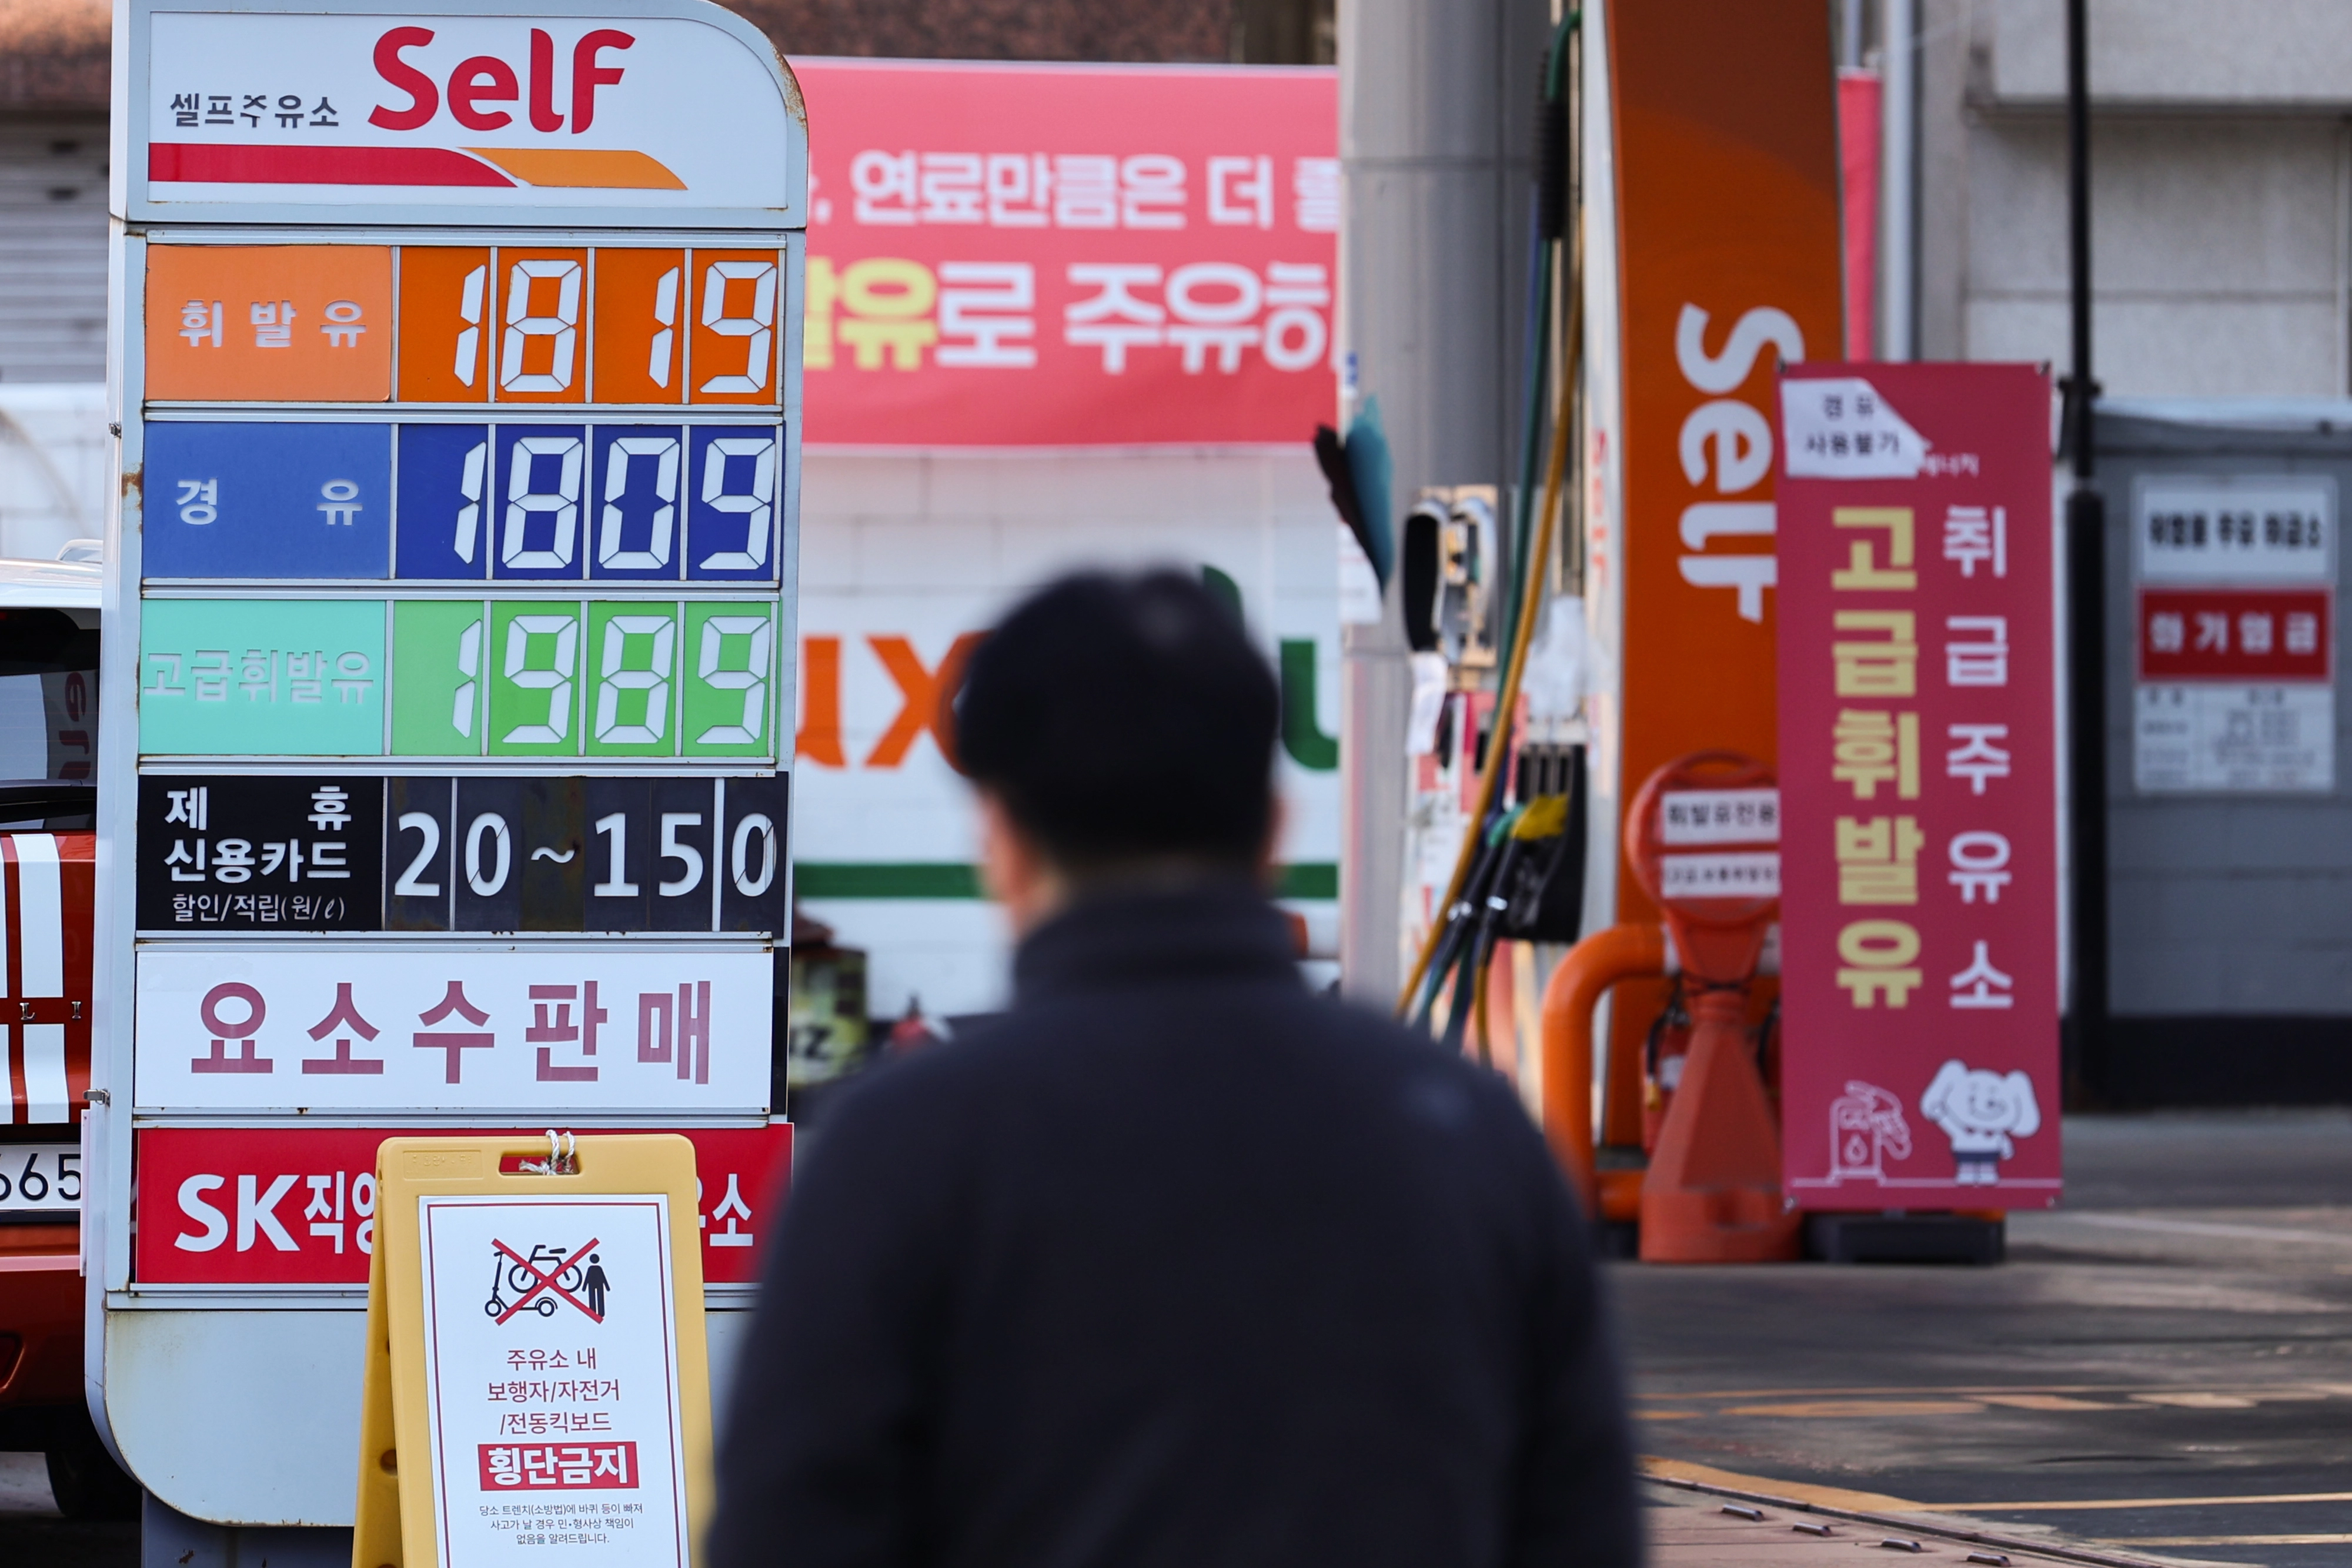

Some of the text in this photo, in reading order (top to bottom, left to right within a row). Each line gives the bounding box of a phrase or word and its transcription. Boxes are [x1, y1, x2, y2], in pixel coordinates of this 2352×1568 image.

[368, 26, 636, 134] Self
[170, 92, 339, 128] 셀프주유소
[851, 151, 1187, 229] 연료만큼은
[1207, 154, 1274, 230] 더
[179, 299, 367, 349] 휘발유
[454, 259, 777, 394] 1819
[454, 437, 776, 570] 1809
[143, 649, 374, 704] 고급휘발유
[452, 615, 771, 745] 1989
[1832, 507, 1925, 1008] 고급휘발유
[1943, 504, 2013, 1009] 취급주유소
[164, 838, 351, 883] 신용카드
[191, 980, 711, 1085] 요소수판매
[696, 1173, 753, 1246] 소
[507, 1347, 597, 1371] 주유소 내
[487, 1379, 620, 1403] 보행자/자전거
[500, 1412, 612, 1436] /전동킥보드
[487, 1445, 629, 1486] 횡단금지
[479, 1503, 643, 1516] 당소 트렌치(소방법)에 바퀴 등이 빠져
[490, 1519, 520, 1530] 사고가
[522, 1519, 532, 1530] 날
[535, 1519, 555, 1530] 경우
[604, 1517, 634, 1529] 책임이
[516, 1533, 610, 1545] 없음을 알려드립니다.
